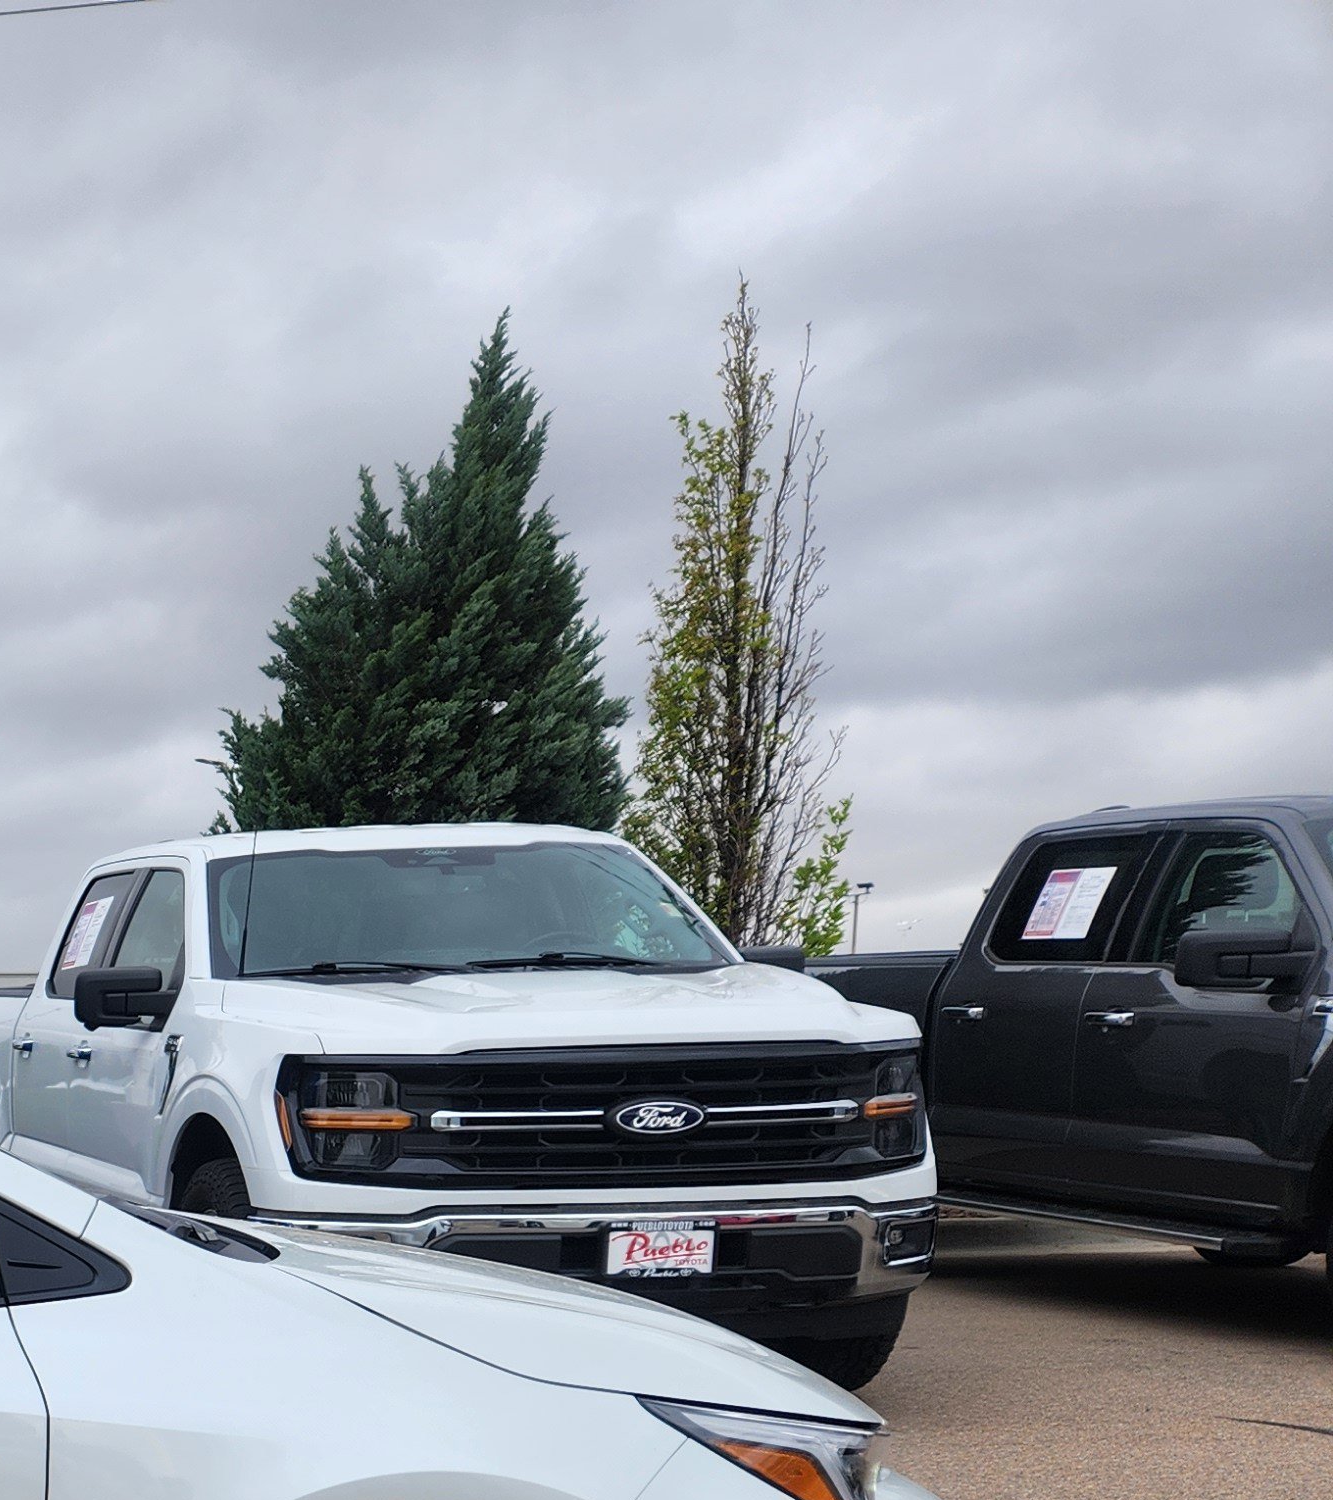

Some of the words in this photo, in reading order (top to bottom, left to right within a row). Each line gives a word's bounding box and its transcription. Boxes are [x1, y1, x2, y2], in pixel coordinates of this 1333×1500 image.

[633, 1106, 687, 1128] Ford
[612, 1232, 709, 1262] Pueblo
[674, 1258, 708, 1266] TOYOTA
